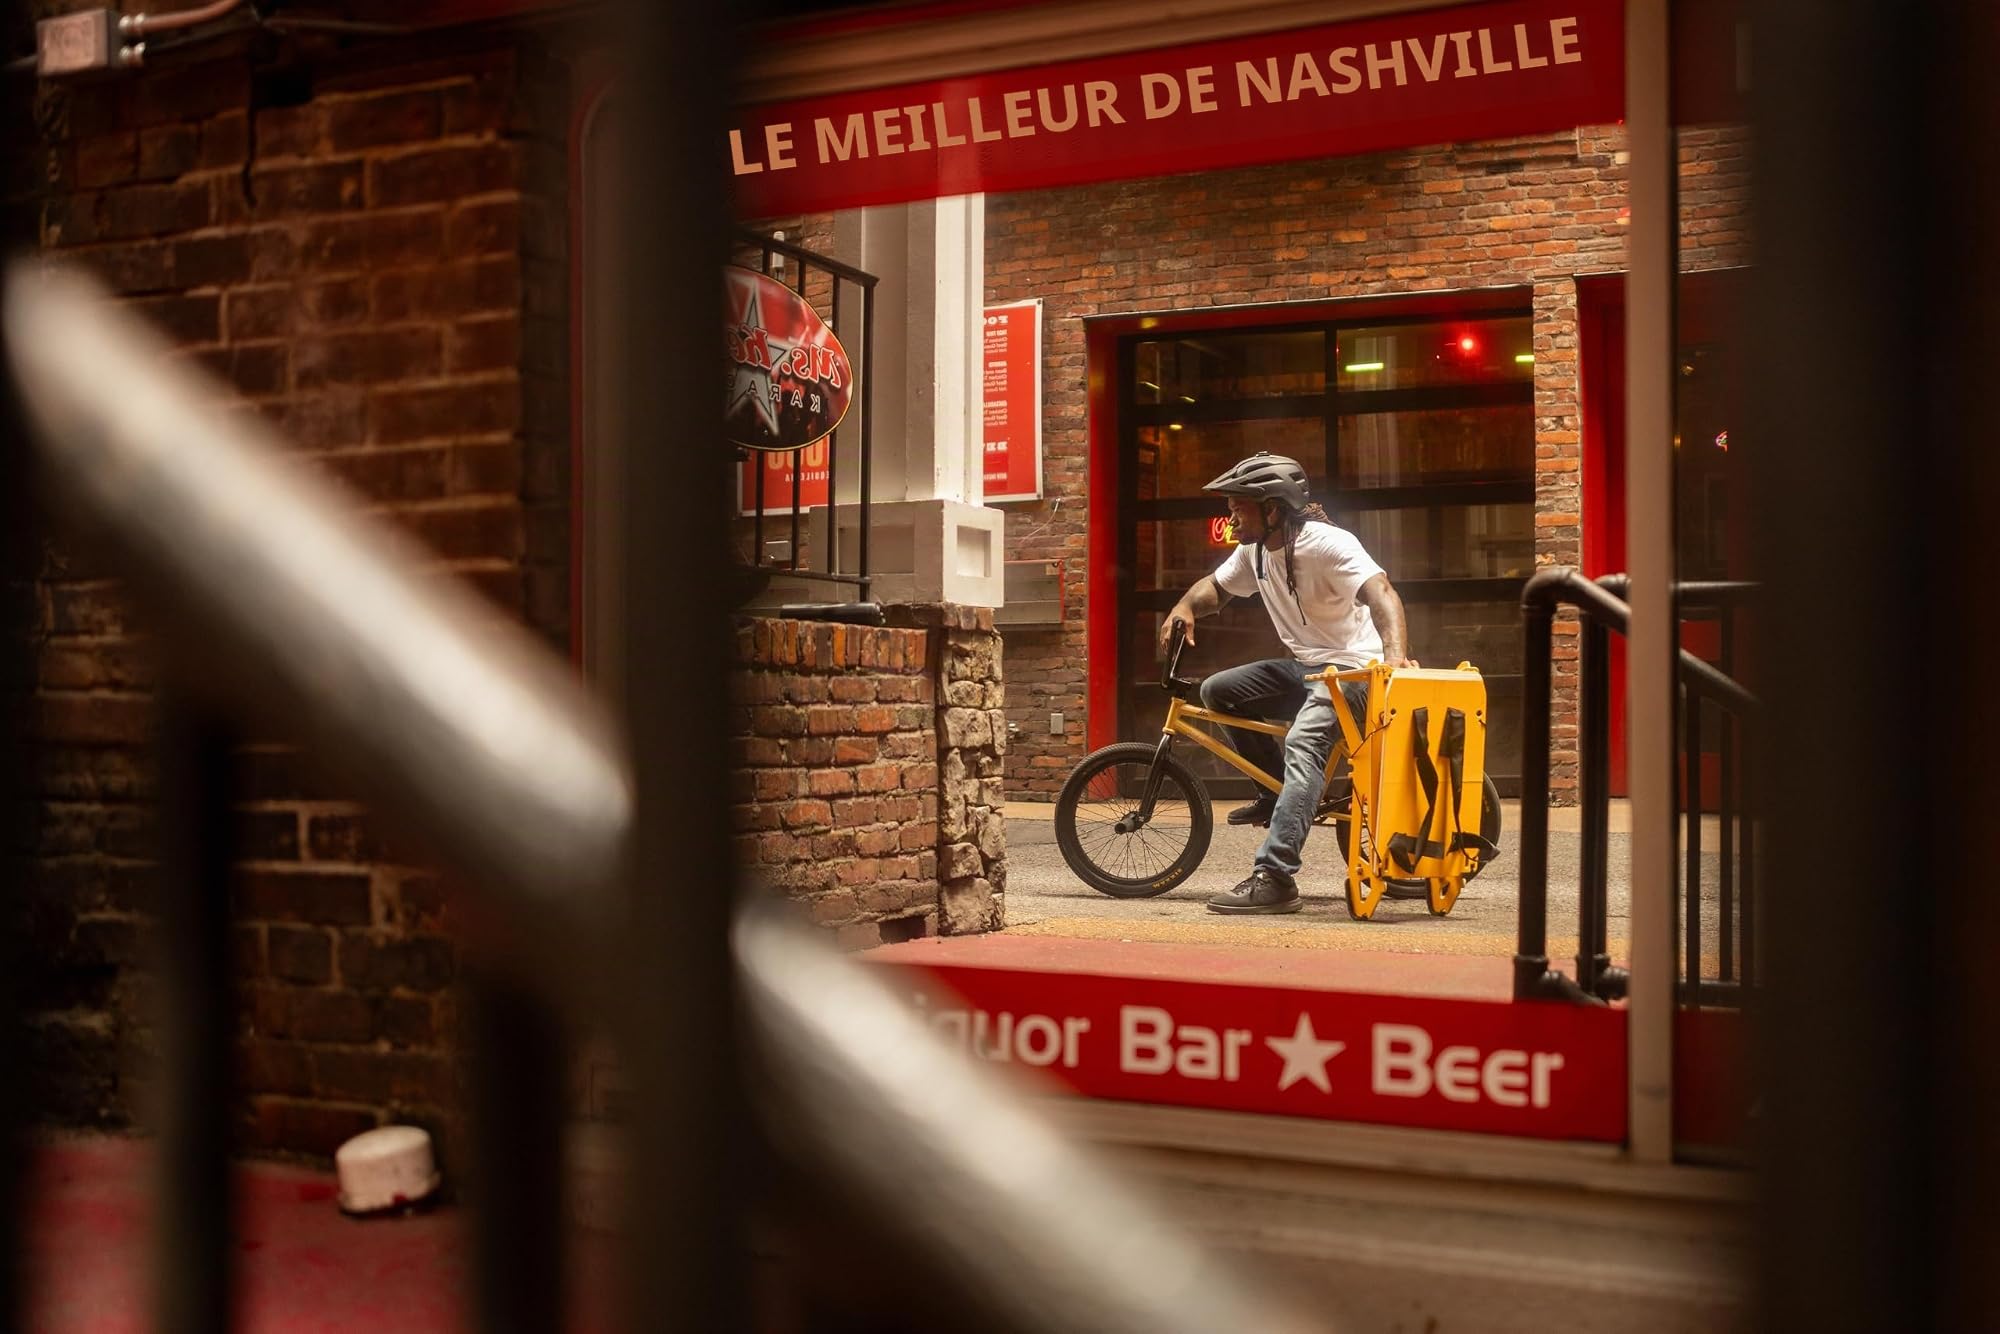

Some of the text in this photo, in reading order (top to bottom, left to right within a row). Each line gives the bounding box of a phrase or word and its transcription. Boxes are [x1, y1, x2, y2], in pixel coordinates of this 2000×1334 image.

[728, 16, 1583, 176] LE MEILLEUR DE NASHVILLE
[1119, 1005, 1252, 1081] Bar
[1371, 1023, 1565, 1110] Beer
